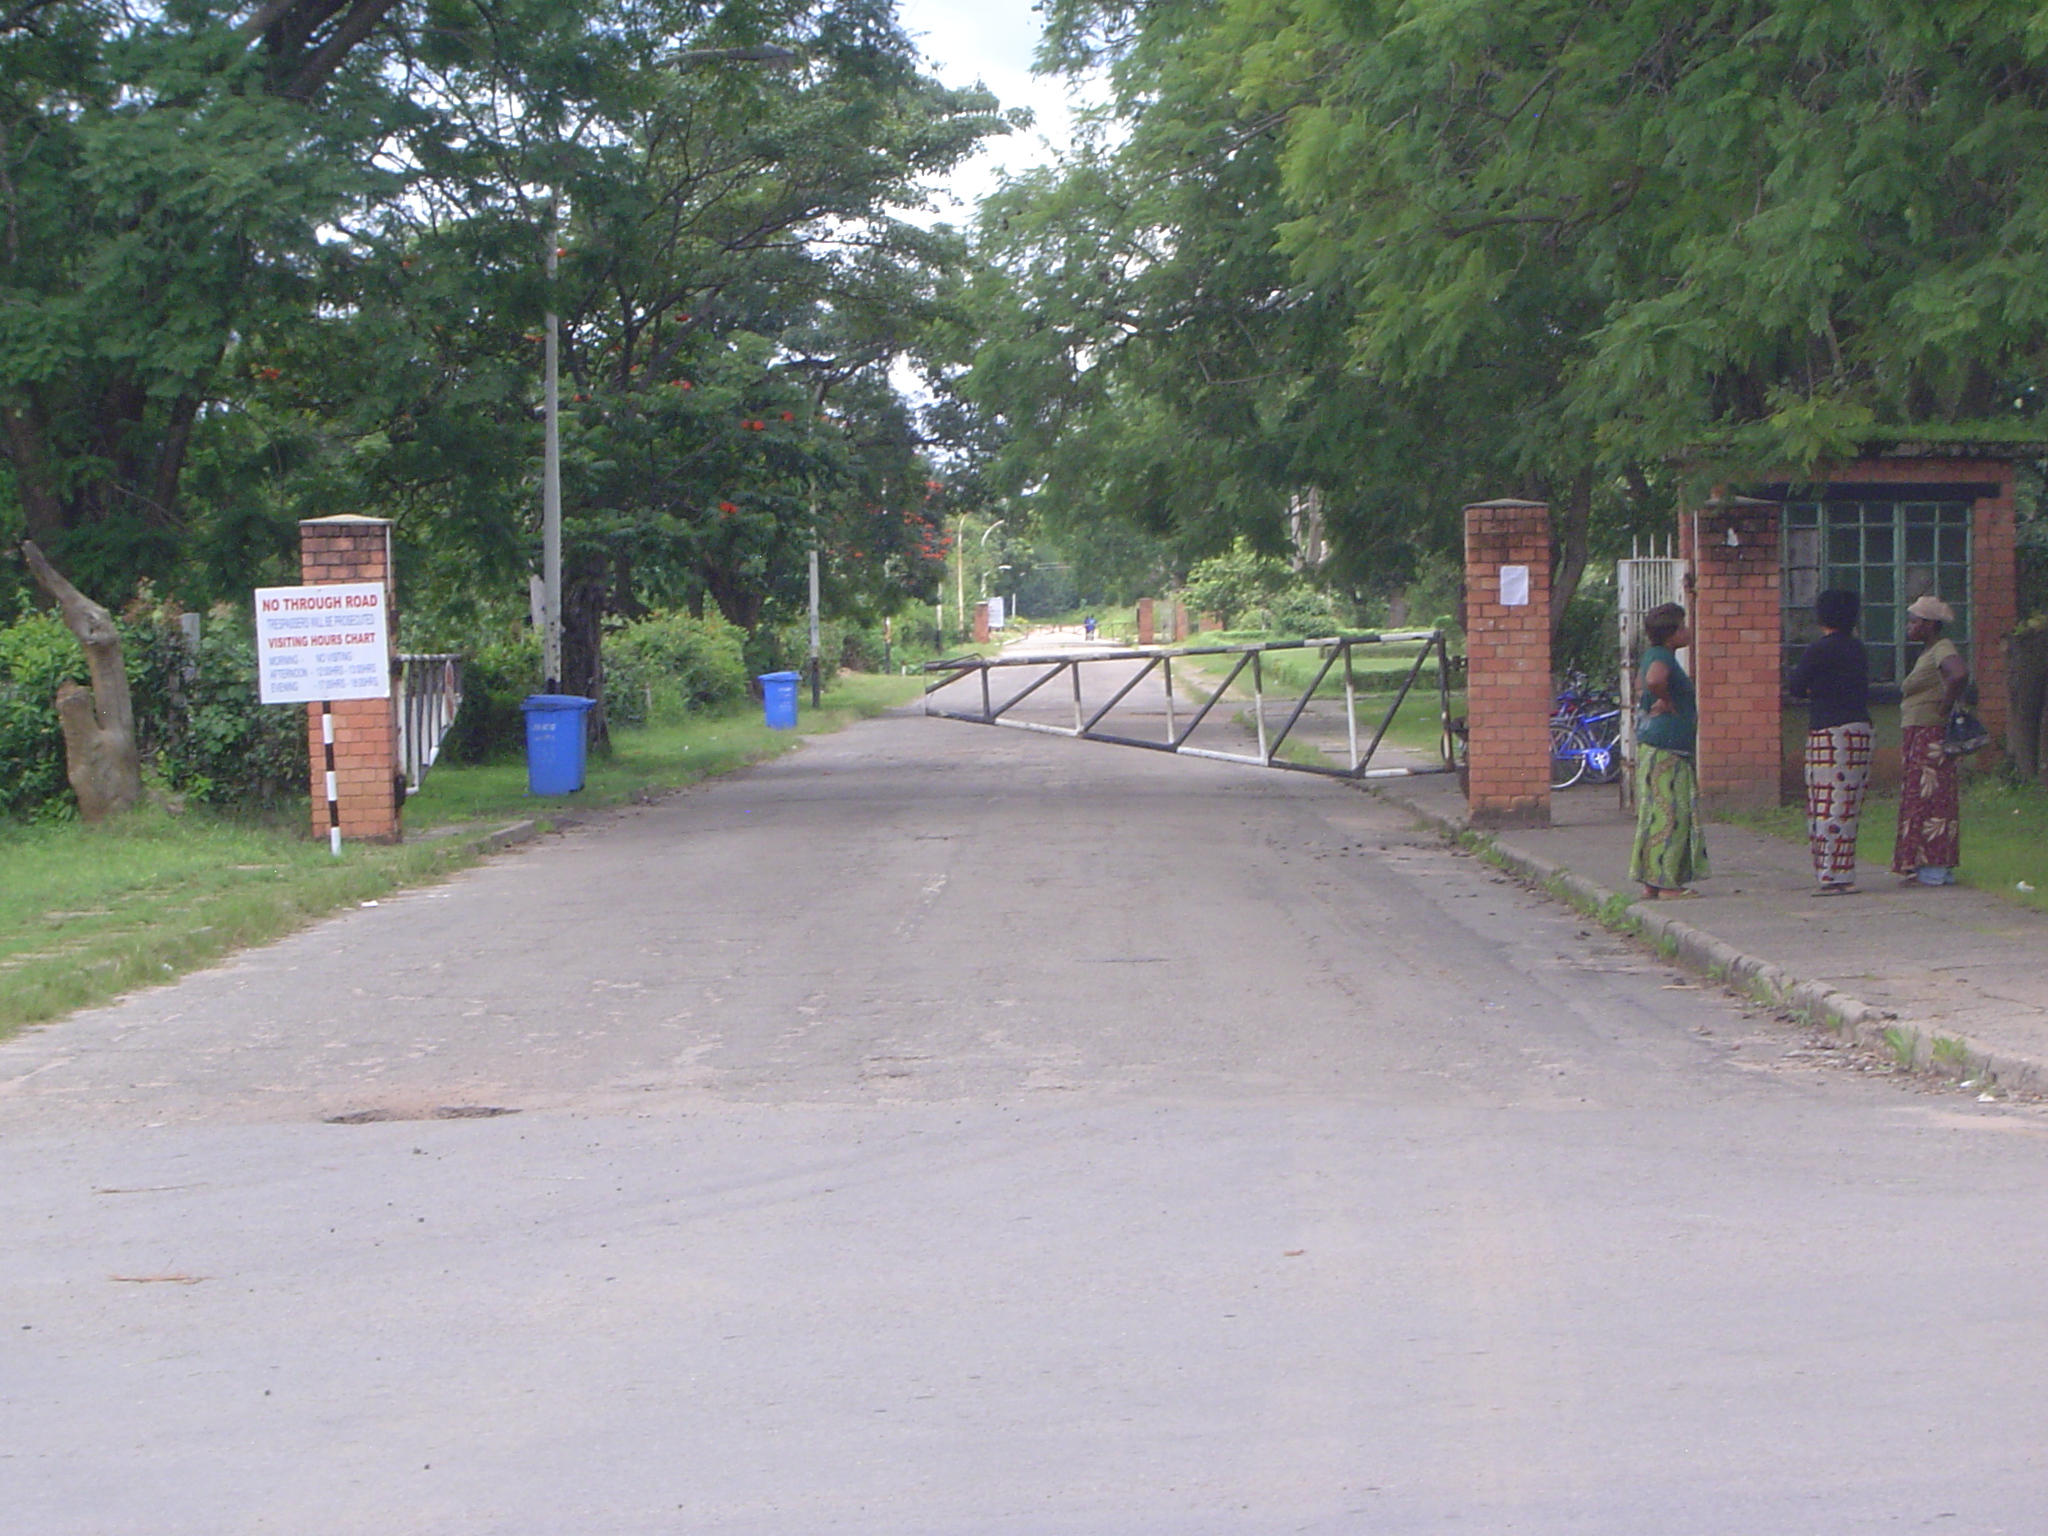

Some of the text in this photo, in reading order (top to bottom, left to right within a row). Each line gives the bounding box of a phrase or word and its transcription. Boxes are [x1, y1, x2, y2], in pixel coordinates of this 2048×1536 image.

[262, 594, 378, 611] NO THROUGH ROAD
[268, 632, 376, 648] VISITING HOURS CHART
